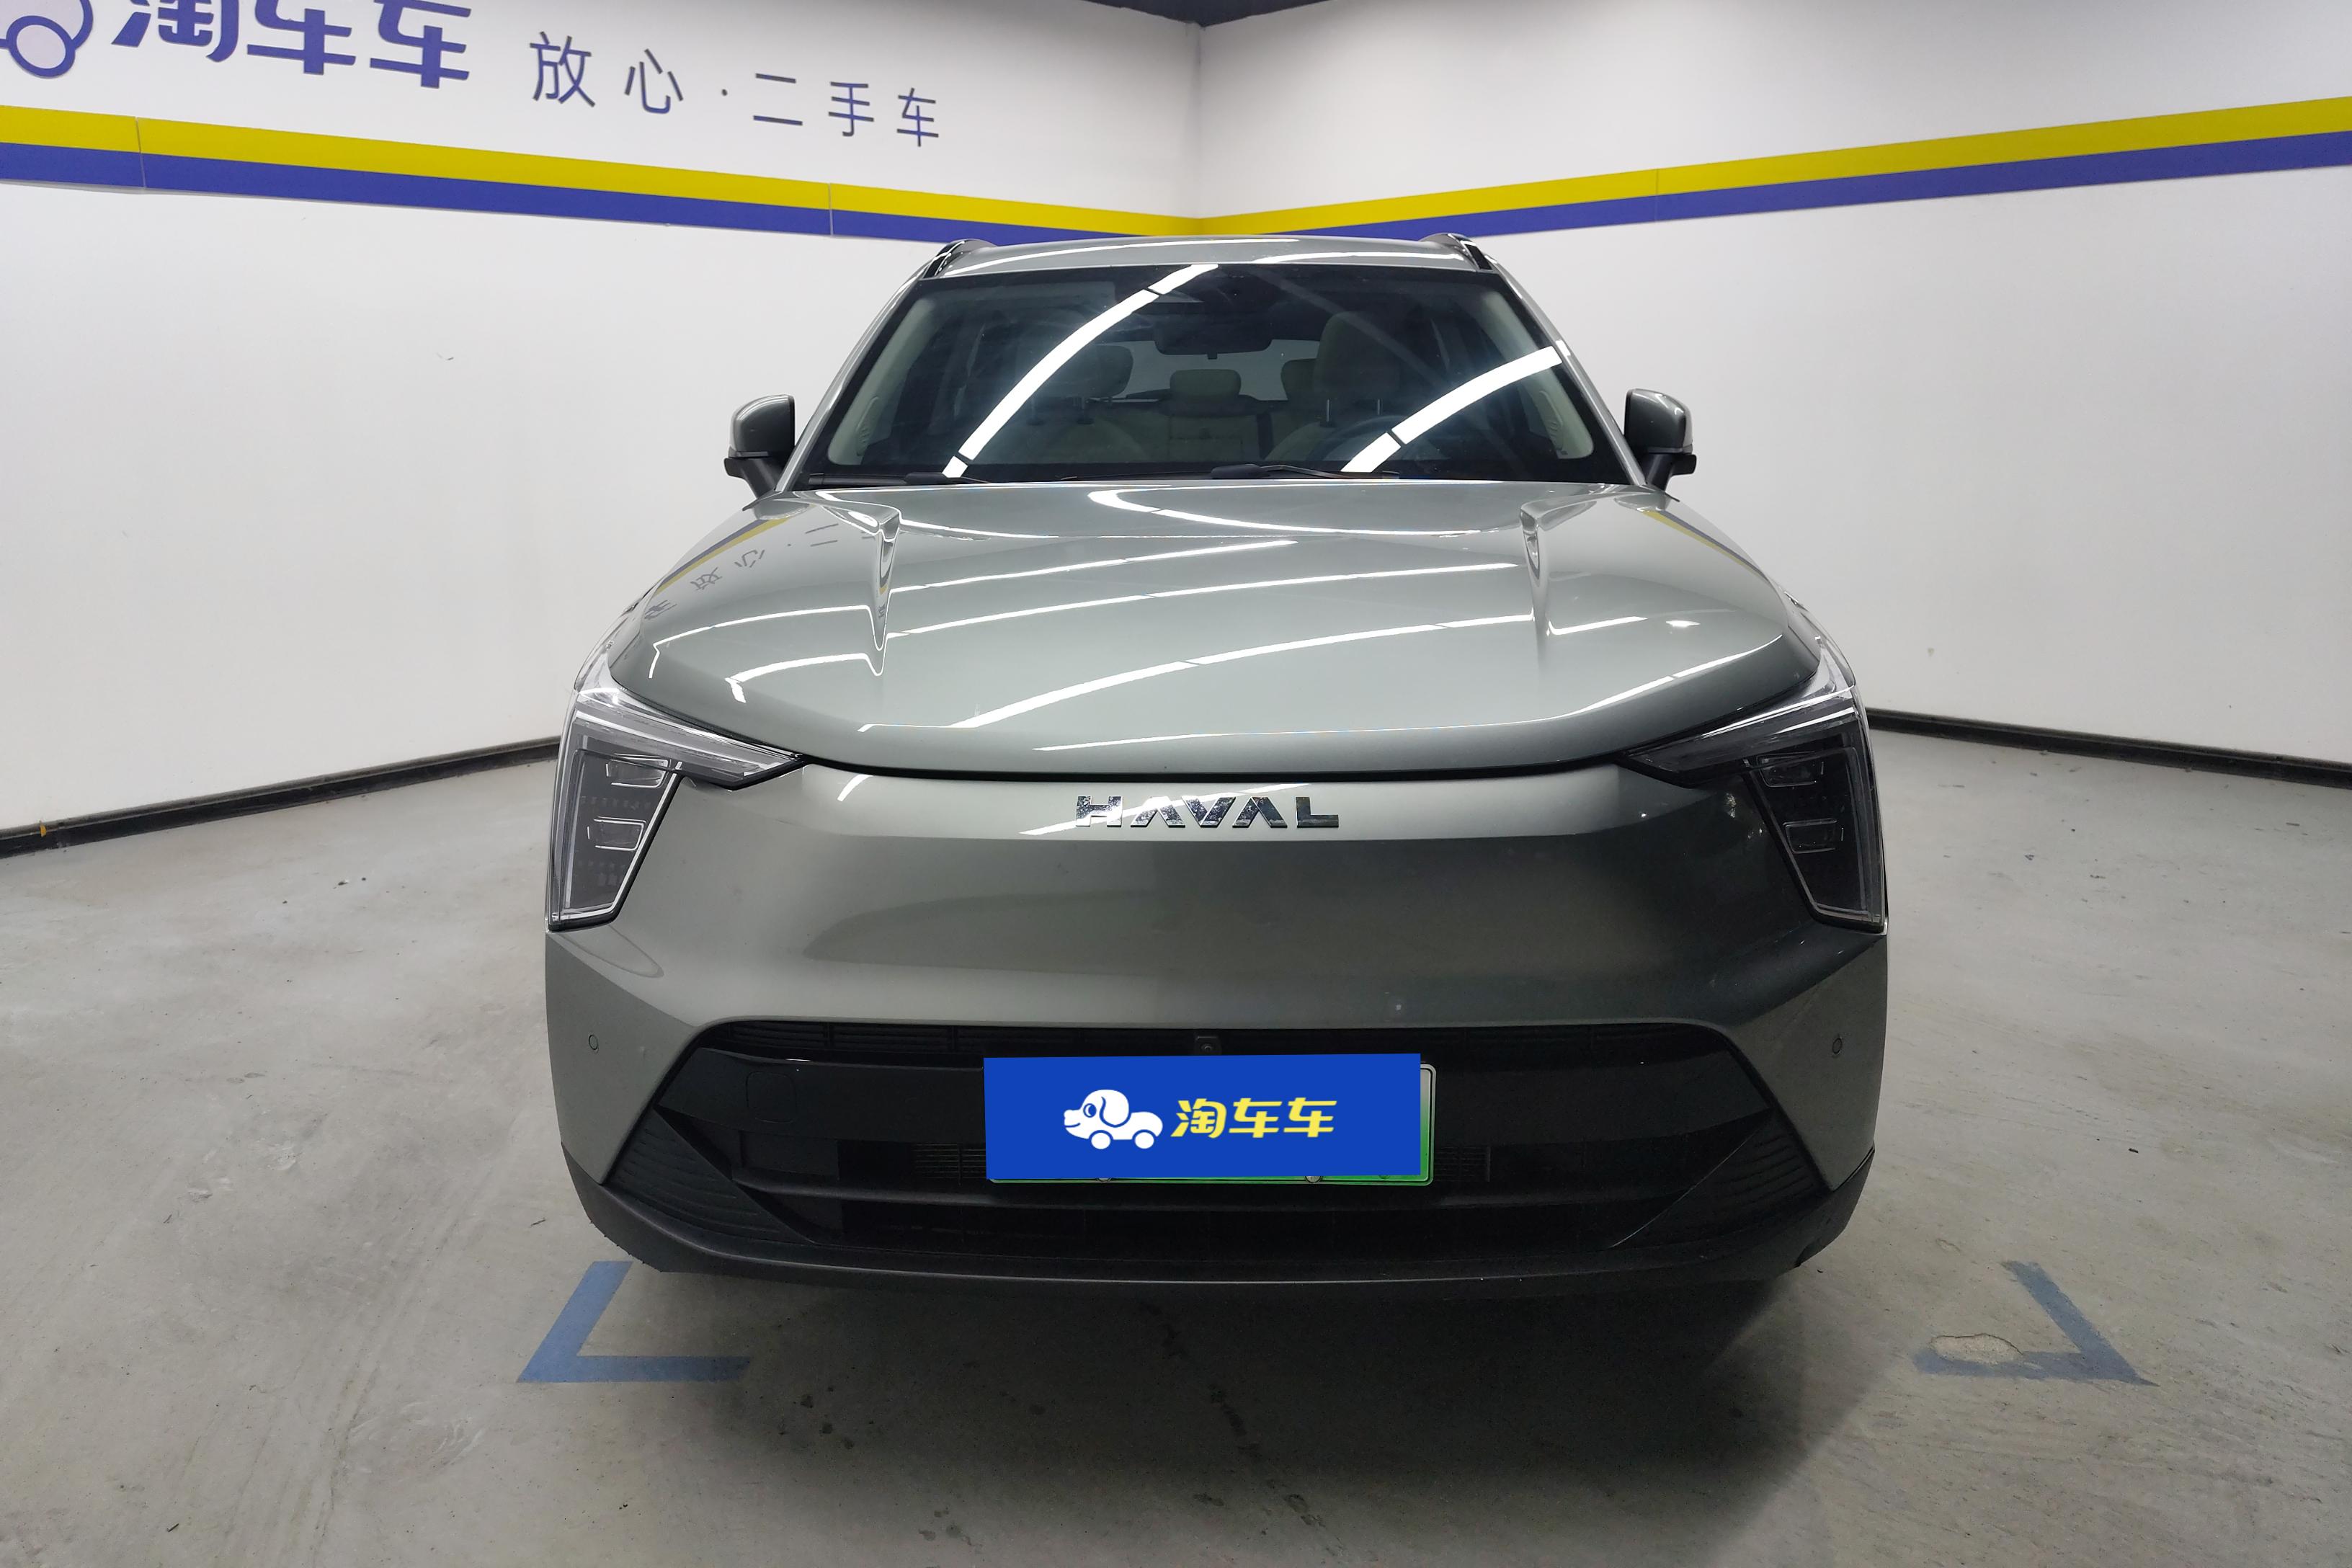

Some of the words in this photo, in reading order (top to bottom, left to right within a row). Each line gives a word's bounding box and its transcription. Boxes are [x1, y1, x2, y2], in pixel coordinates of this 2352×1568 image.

[530, 31, 939, 147] 放心·二手车
[1075, 795, 1340, 828] HAVAL
